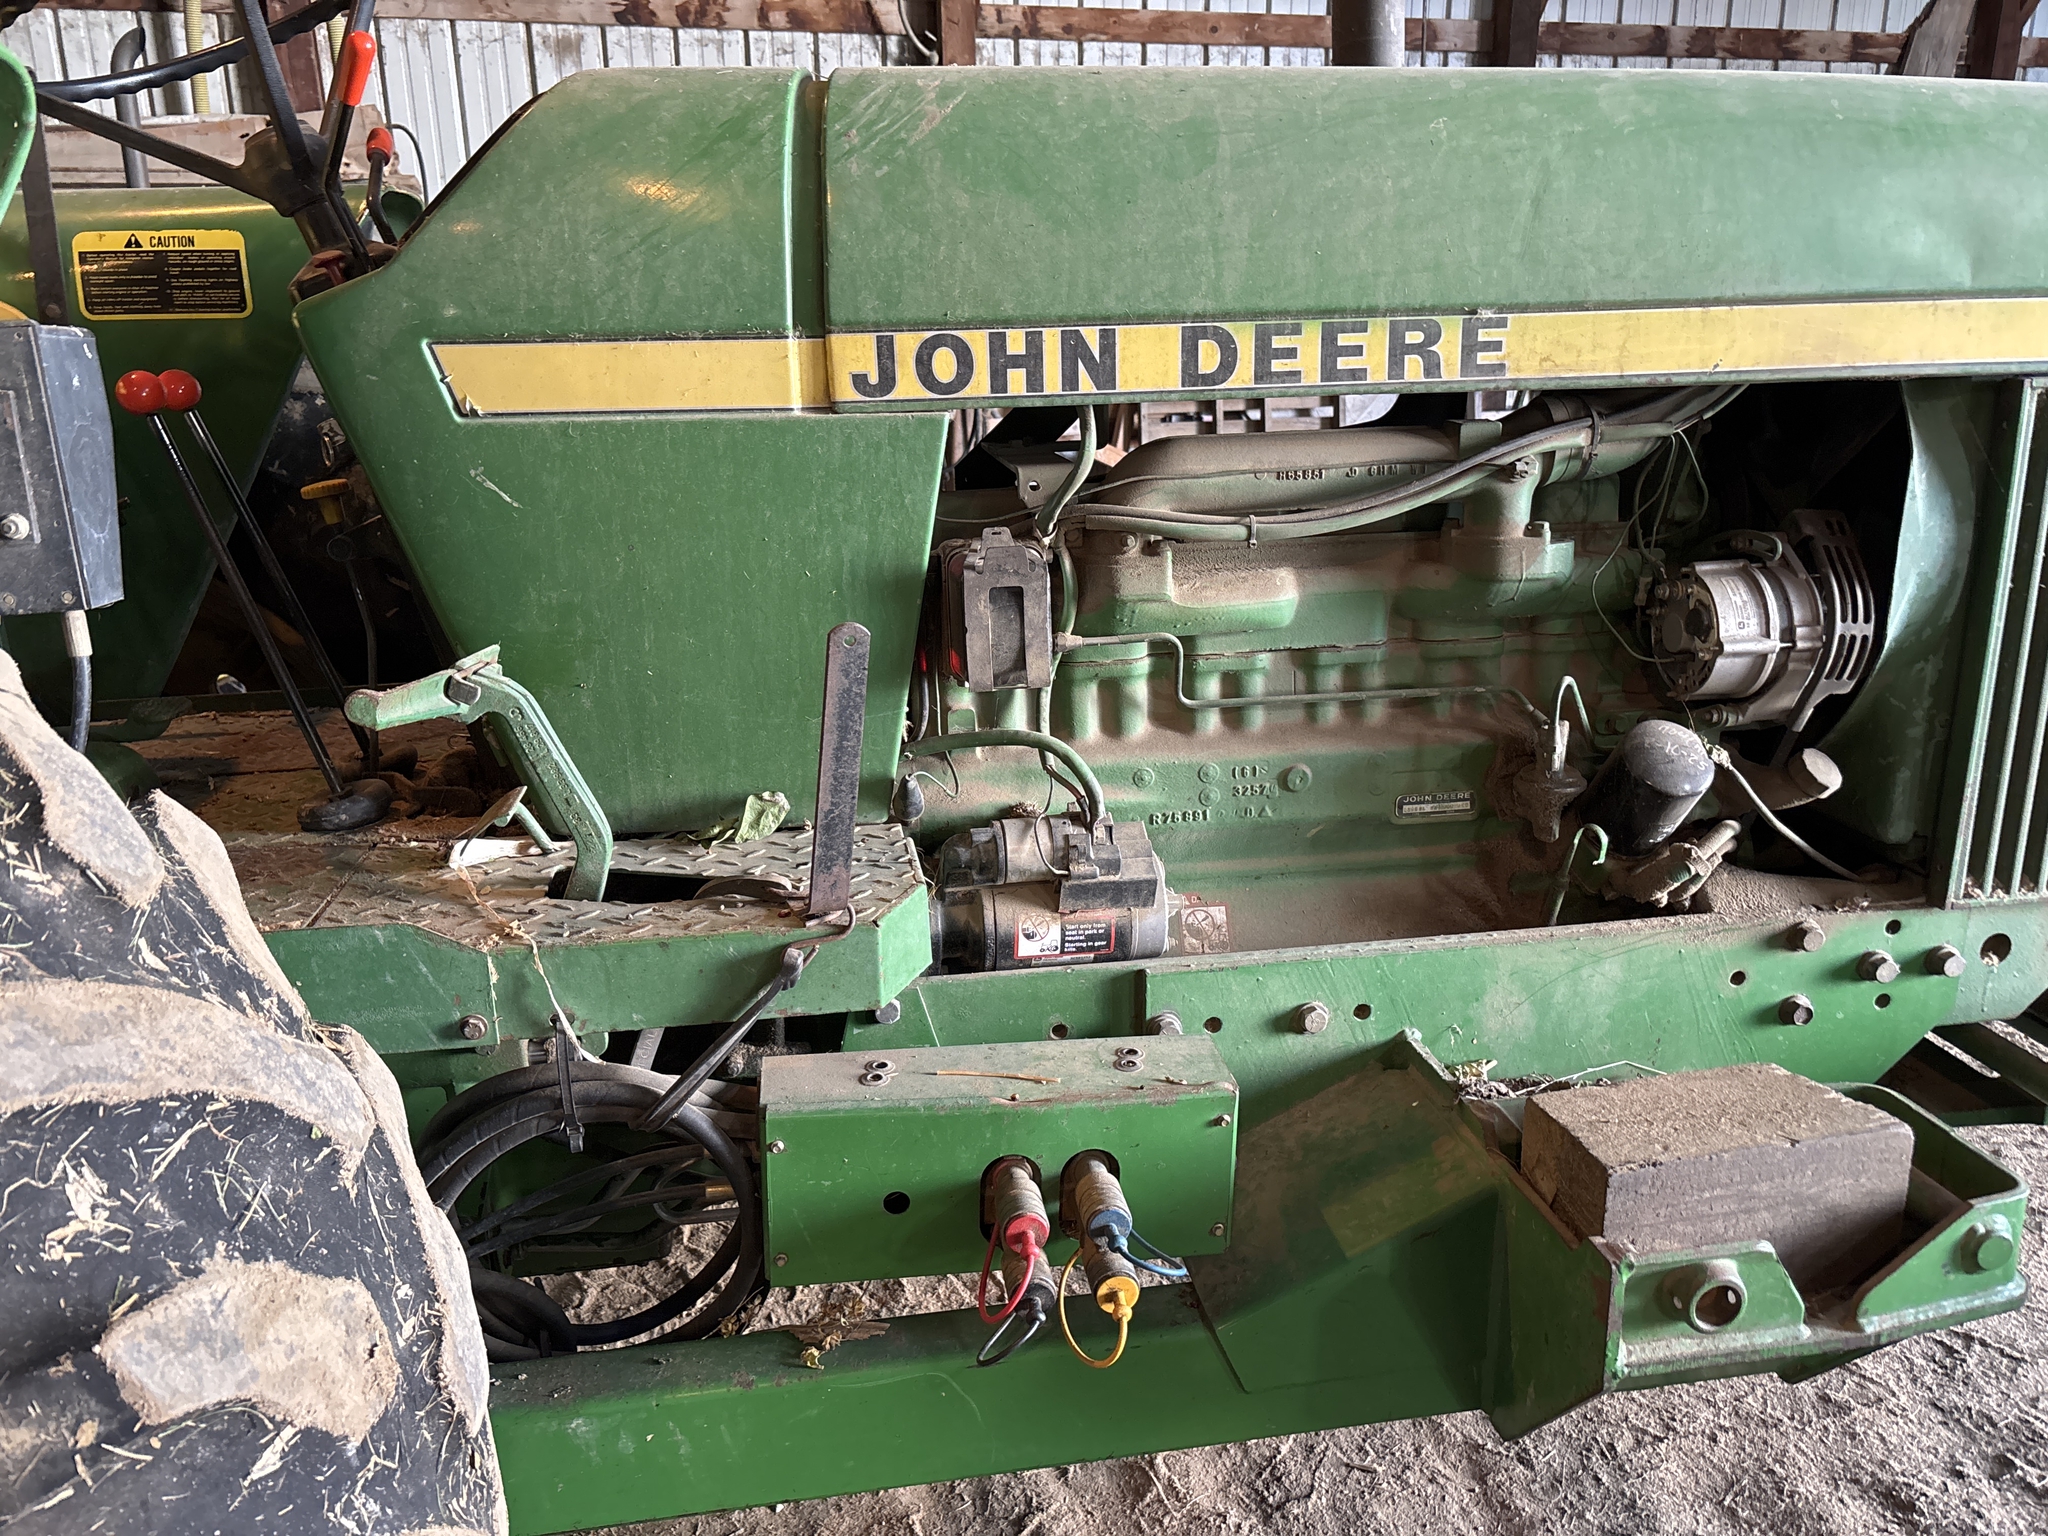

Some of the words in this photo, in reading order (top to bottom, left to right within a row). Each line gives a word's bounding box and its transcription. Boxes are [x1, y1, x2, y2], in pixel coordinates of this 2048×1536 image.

[149, 235, 195, 248] CAUTION
[848, 327, 1116, 399] JOHN
[1180, 316, 1509, 390] DEERE
[1403, 794, 1432, 803] JOHN
[1436, 791, 1471, 801] DEERE
